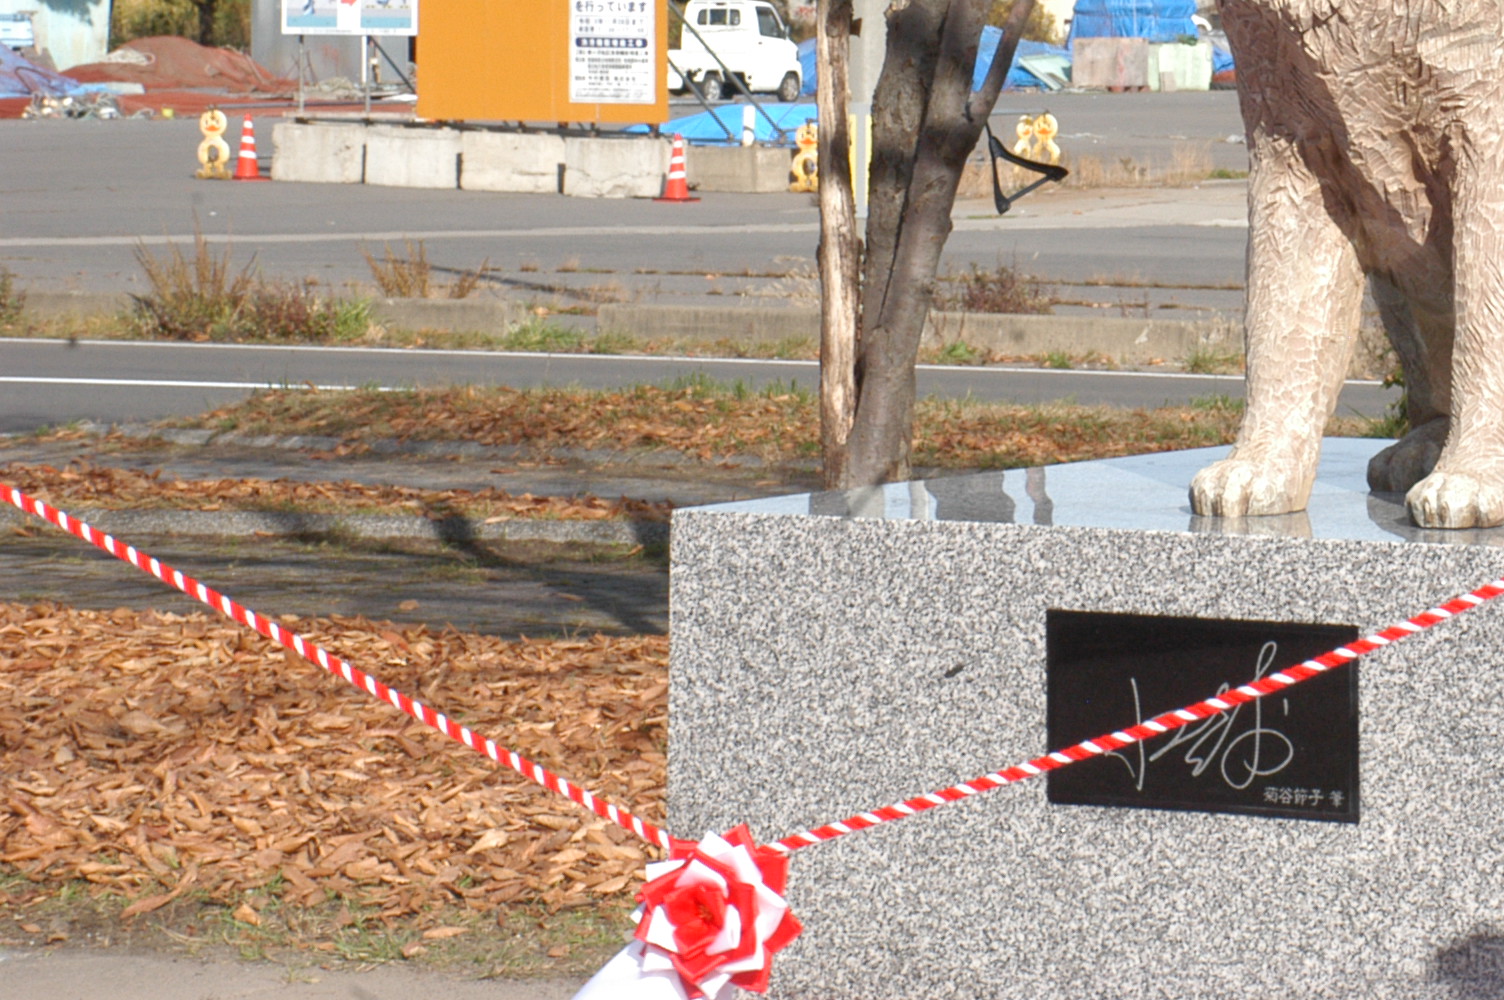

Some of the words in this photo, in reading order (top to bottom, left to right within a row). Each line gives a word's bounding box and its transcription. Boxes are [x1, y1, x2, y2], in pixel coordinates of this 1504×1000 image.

[576, 0, 647, 12] を行っています
[1263, 786, 1324, 806] 菊谷節子
[1329, 790, 1344, 808] 筆
